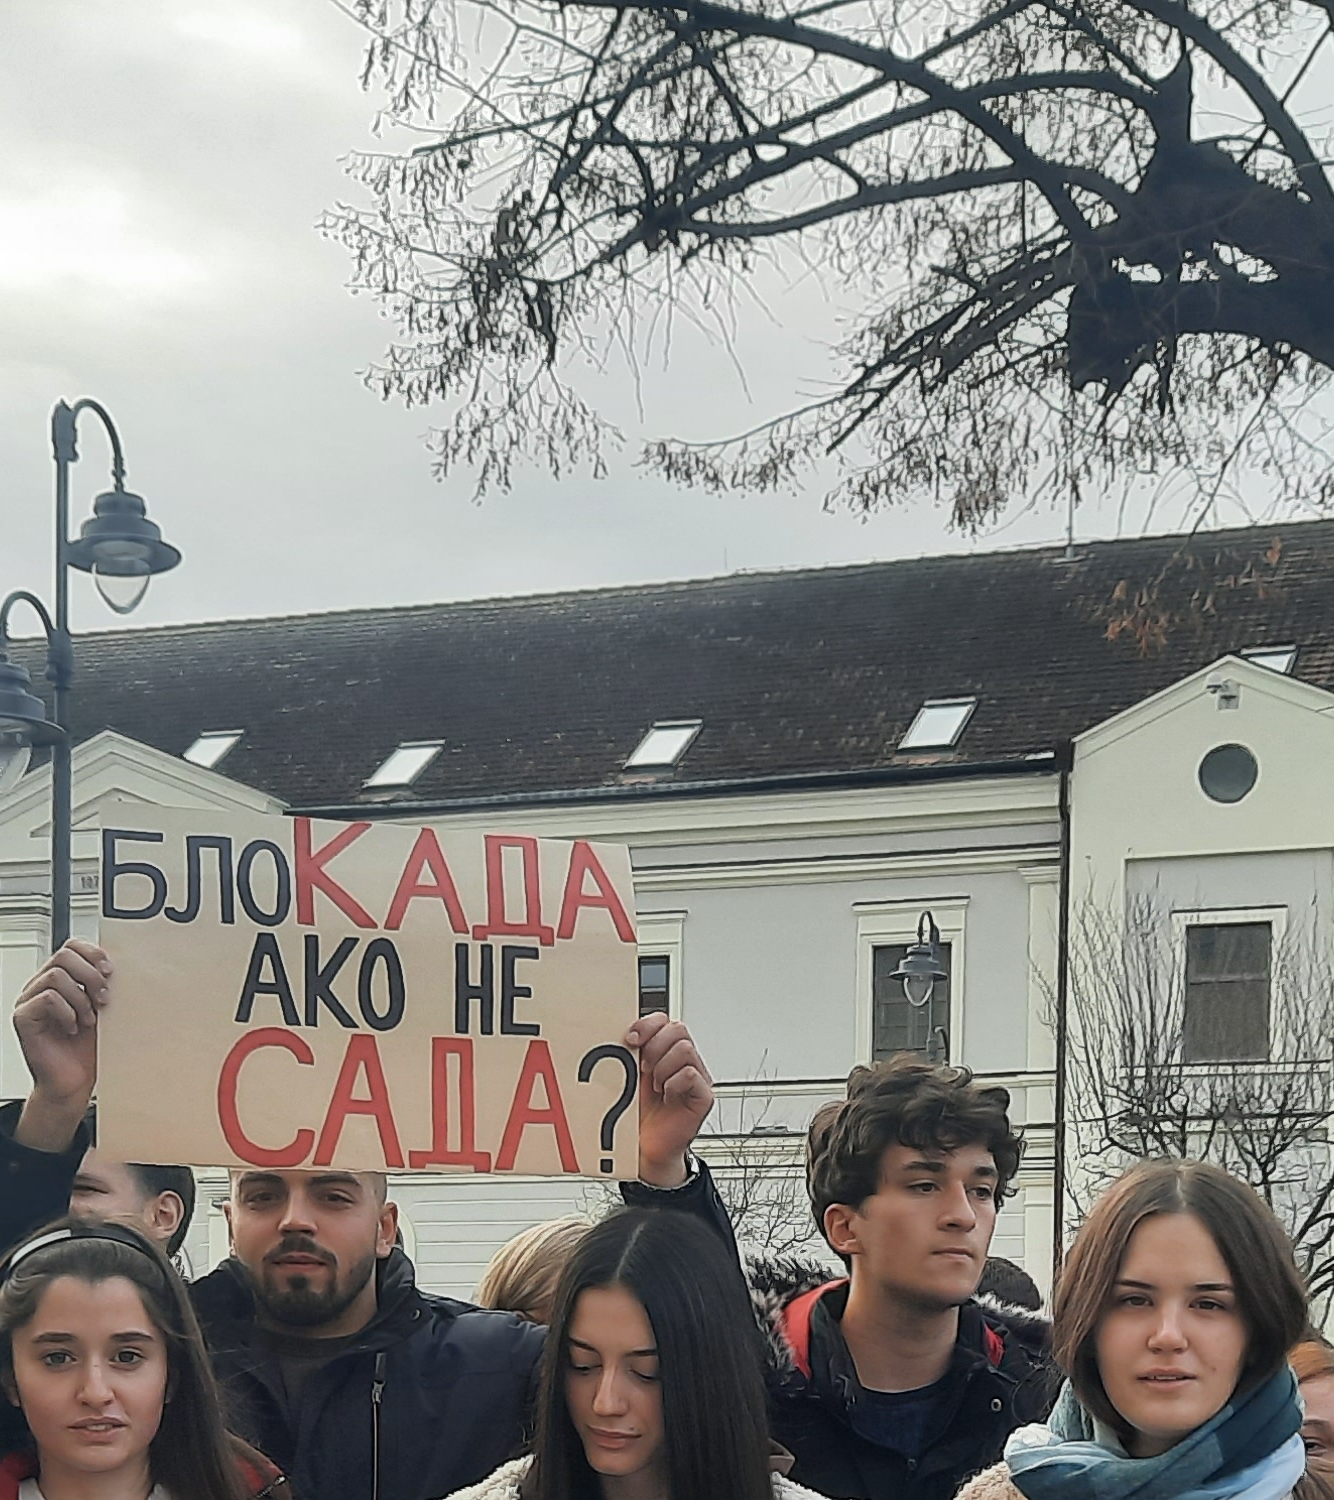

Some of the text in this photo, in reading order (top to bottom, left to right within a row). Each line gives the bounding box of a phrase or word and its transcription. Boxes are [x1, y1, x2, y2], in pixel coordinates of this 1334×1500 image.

[102, 816, 637, 947] БЛОКАДА
[234, 933, 541, 1036] АКО НЕ
[217, 1026, 638, 1174] САДА?
